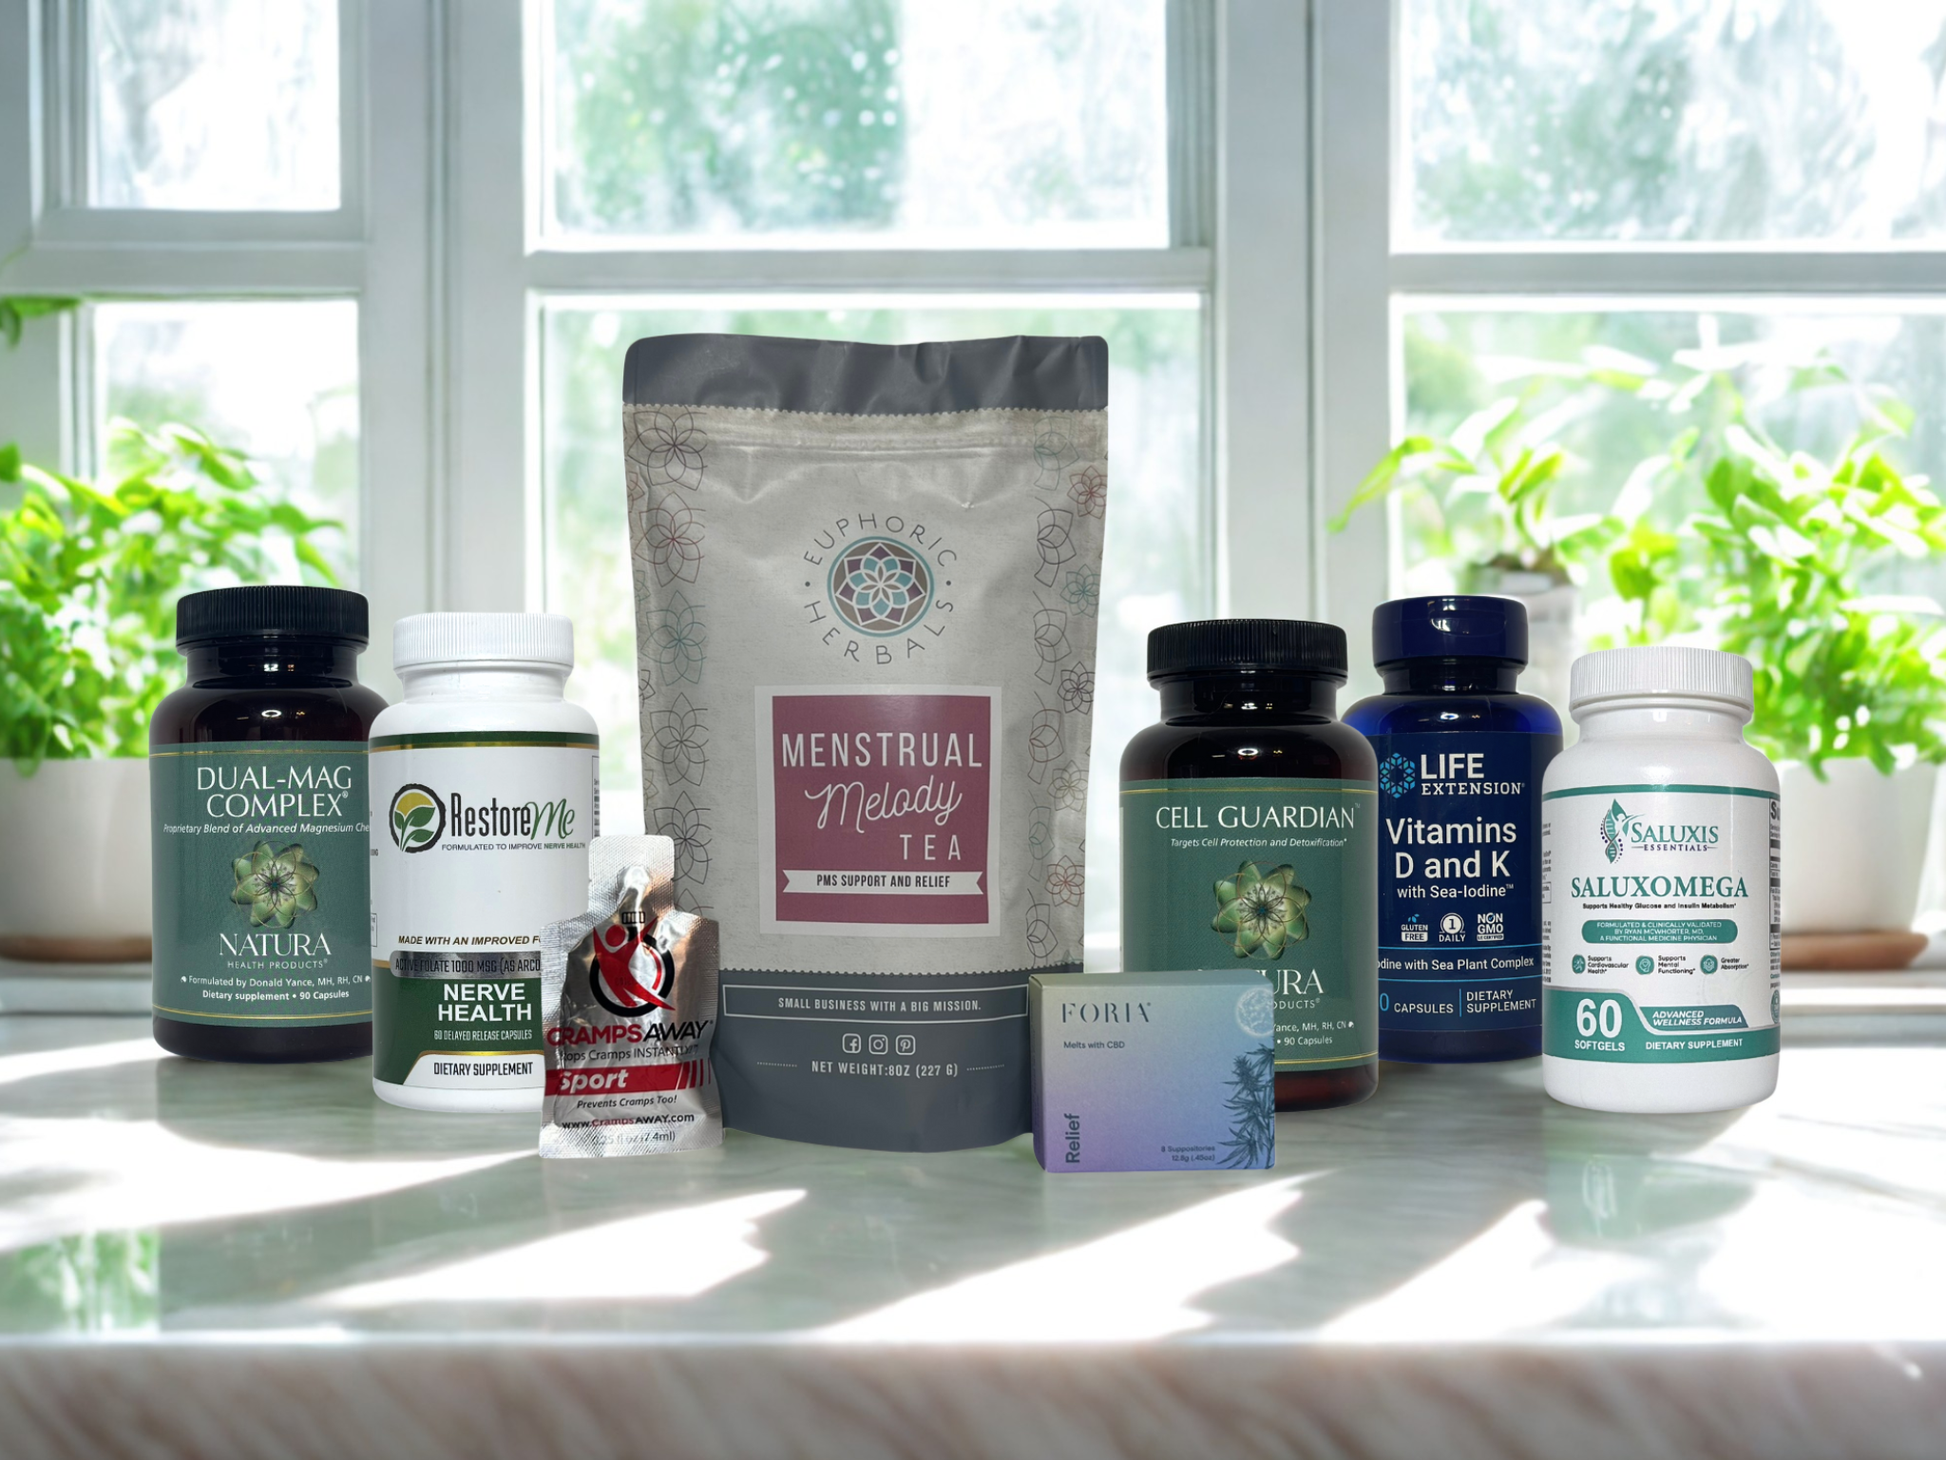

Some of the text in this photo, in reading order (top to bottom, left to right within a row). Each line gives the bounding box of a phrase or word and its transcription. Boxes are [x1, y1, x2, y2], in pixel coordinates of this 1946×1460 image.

[803, 512, 958, 567] EUPHORIC
[804, 599, 954, 665] HERBALS
[782, 732, 982, 767] MENSTRUAL
[1421, 753, 1484, 780] LIFE
[197, 765, 351, 790] DUAL-MAG
[804, 775, 963, 833] Melody
[451, 792, 575, 840] RestoreMe
[1156, 806, 1208, 829] CELL
[163, 823, 202, 835] Proprietary
[204, 824, 229, 833] Blend
[232, 824, 243, 833] of
[245, 823, 296, 833] Advanced
[300, 823, 353, 834] Magnesium
[1386, 816, 1517, 844] Vitamins
[1631, 822, 1719, 844] SALUXIS
[900, 834, 961, 860] TEA
[1171, 839, 1199, 849] Targets
[1201, 838, 1218, 847] Cell
[1220, 838, 1267, 847] Protection
[1270, 838, 1287, 847] and
[1395, 852, 1414, 879] D
[1424, 850, 1480, 878] and
[1492, 850, 1510, 878] K
[817, 874, 951, 887] PMS SUPPORT AND RELIEF
[1571, 876, 1749, 898] SALUXOMEGA
[1397, 885, 1426, 898] with
[1449, 919, 1456, 930] 1
[1477, 912, 1503, 924] NON
[1477, 924, 1503, 934] GMO
[219, 932, 332, 956] NATURA
[398, 936, 530, 945] MADE WITH AN IMPROVED
[227, 961, 264, 969] HEALTH
[396, 958, 419, 971] ACTIVE
[420, 960, 450, 972] FOLATE
[452, 960, 474, 972] 1000
[500, 958, 515, 974] (AS
[1405, 959, 1428, 970] with
[1432, 959, 1454, 970] Sea
[1457, 958, 1487, 970] Plant
[1491, 956, 1534, 970] Complex
[189, 975, 362, 988] Formulated by Donald Yance, MH, RH, CN
[202, 990, 349, 1001] Dietary supplement 90 Capsules
[444, 983, 526, 1001] NERVE
[1466, 989, 1513, 1001] DIETARY
[778, 998, 982, 1012] SMALL BUSINESS WITH A BIG MISSION.
[1394, 1003, 1454, 1014] CAPSULES
[1466, 999, 1537, 1013] SUPPLEMENT
[438, 1004, 532, 1021] HEALTH
[1576, 998, 1622, 1038] 60
[1652, 1010, 1704, 1019] ADVANCED
[1302, 1023, 1319, 1031] MH,
[1322, 1022, 1334, 1030] RH,
[1653, 1017, 1742, 1026] WELLNESS FORMULA
[434, 1030, 532, 1040] 60 DELAYED RELEASE CAPSULES
[1284, 1036, 1333, 1046] 90 Capsules
[1063, 1041, 1125, 1049] Melts with CBD
[1574, 1039, 1625, 1051] SOFTGELS
[1646, 1039, 1743, 1050] DIETARY SUPPLEMENT
[588, 1050, 630, 1061] Cramps
[434, 1062, 533, 1076] DIETARY SUPPLEMENT
[811, 1061, 833, 1073] NET
[916, 1065, 941, 1078] (227
[946, 1063, 958, 1077] G)
[561, 1069, 629, 1094] Sport
[577, 1095, 677, 1109] Prevents Cramps Too!
[562, 1113, 694, 1129] www.CrampsAWAY.com
[1064, 1113, 1080, 1163] Relief
